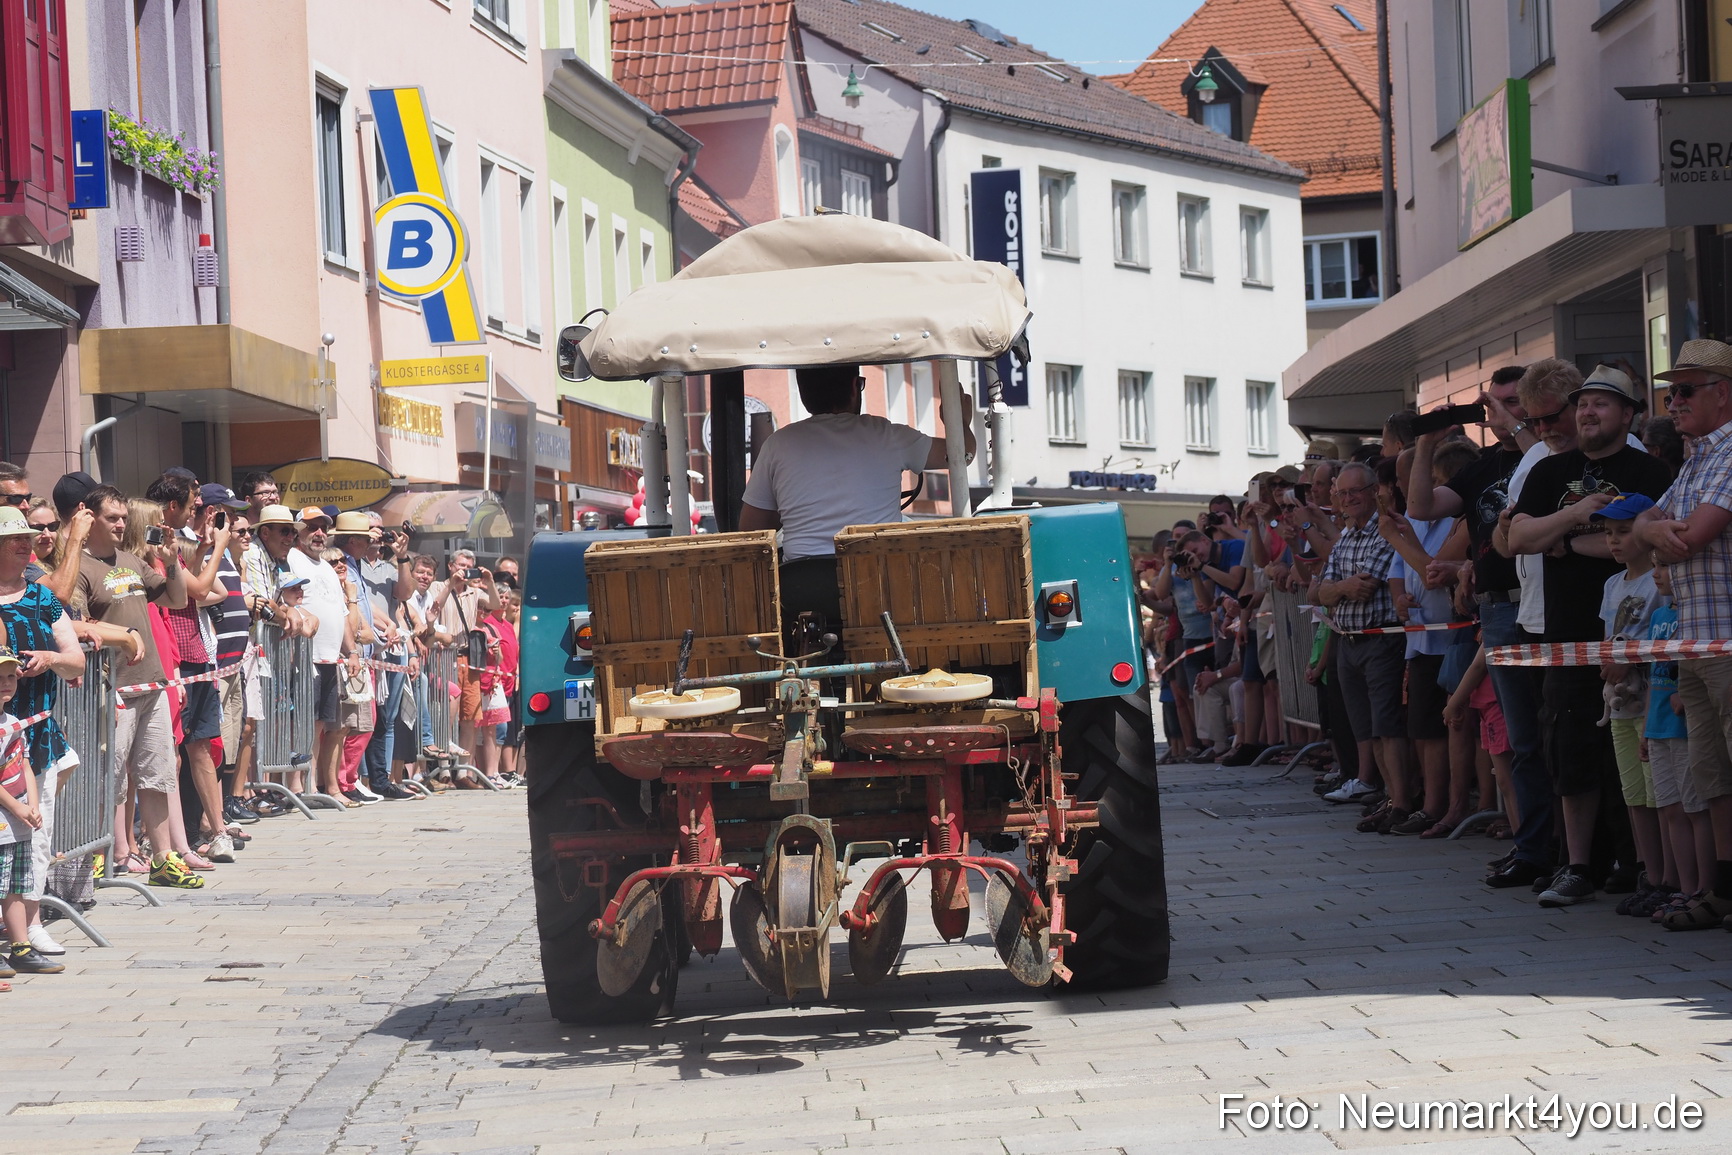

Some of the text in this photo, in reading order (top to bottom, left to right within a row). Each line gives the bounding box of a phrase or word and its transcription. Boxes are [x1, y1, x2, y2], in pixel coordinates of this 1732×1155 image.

[1671, 171, 1707, 183] MODE
[1711, 170, 1720, 181] &
[387, 219, 433, 270] B
[386, 363, 480, 379] KLOSTERGASSE 4
[290, 479, 389, 493] GOLDSCHMIEDE
[299, 495, 353, 504] JUTTA ROTHER
[579, 701, 590, 717] H
